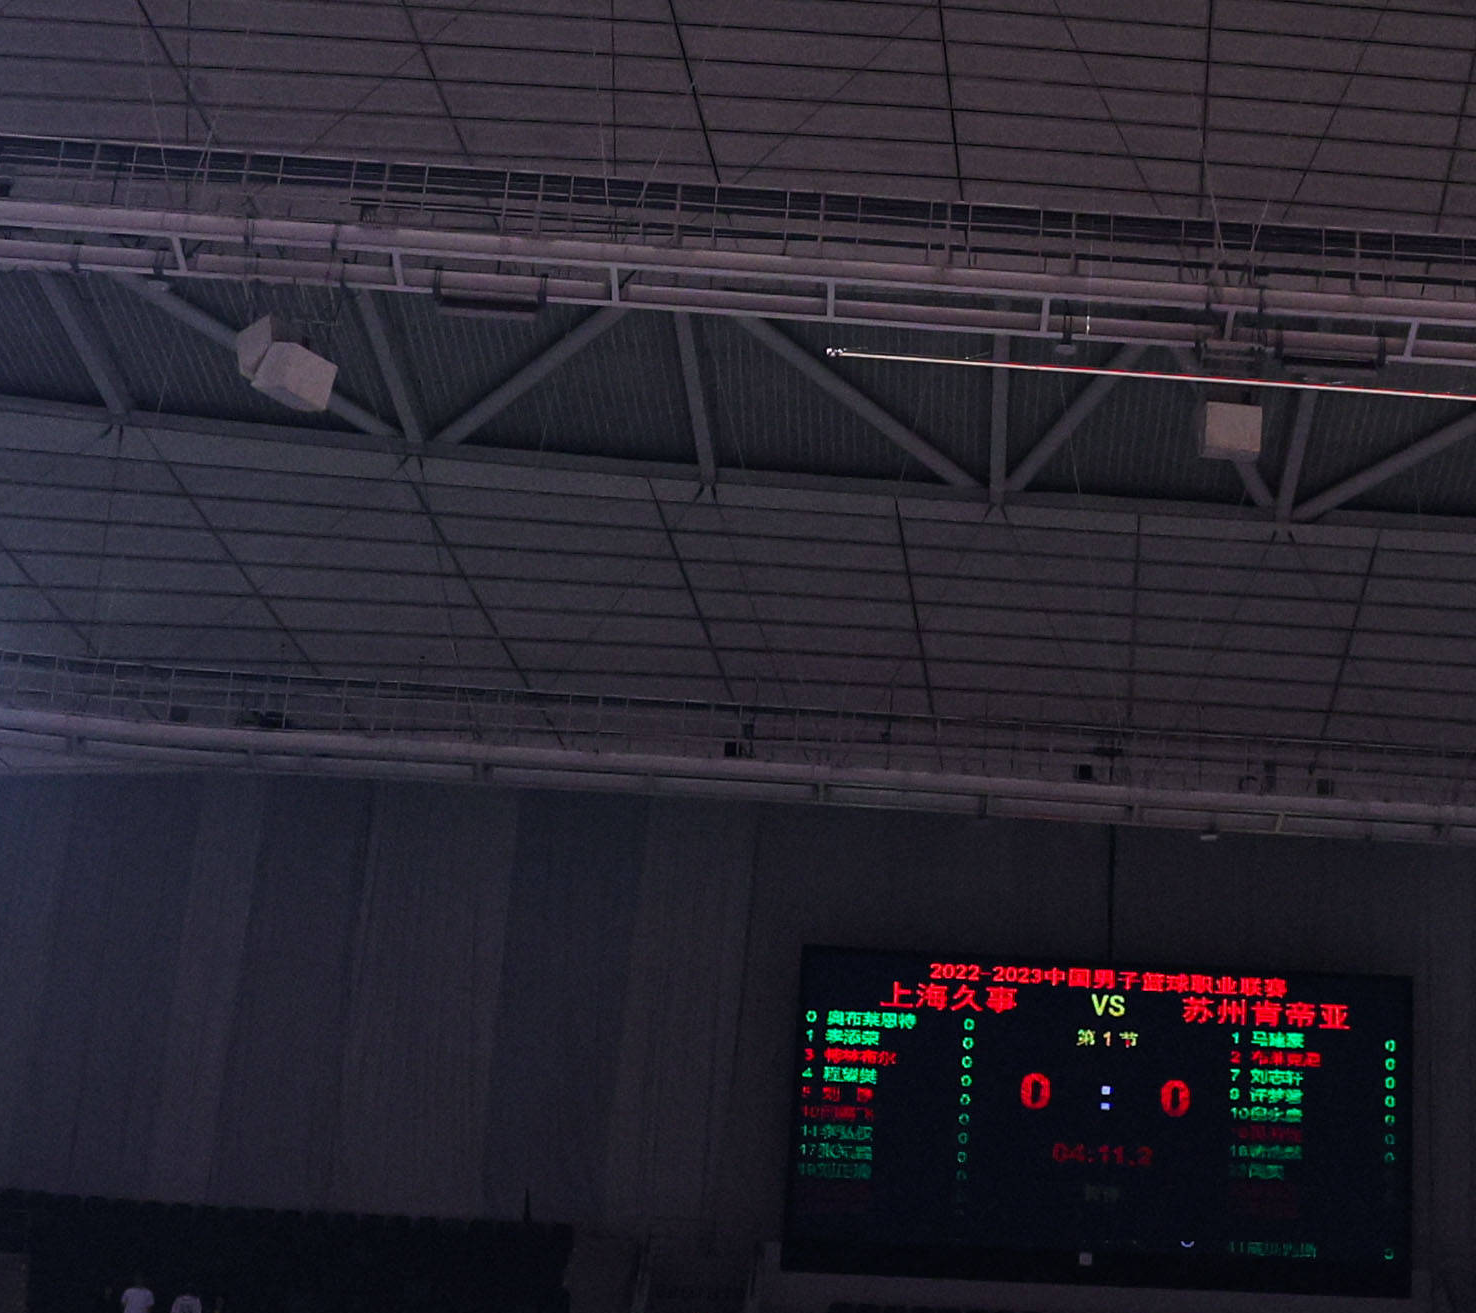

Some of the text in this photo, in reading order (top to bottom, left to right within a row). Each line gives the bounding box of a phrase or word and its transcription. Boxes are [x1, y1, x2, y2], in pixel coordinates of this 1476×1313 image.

[880, 980, 1018, 1014] 上海久事
[1091, 993, 1126, 1018] VS
[1182, 995, 1351, 1031] 苏州肯帝亚
[1021, 1072, 1051, 1110] 0
[1160, 1079, 1190, 1118] 0
